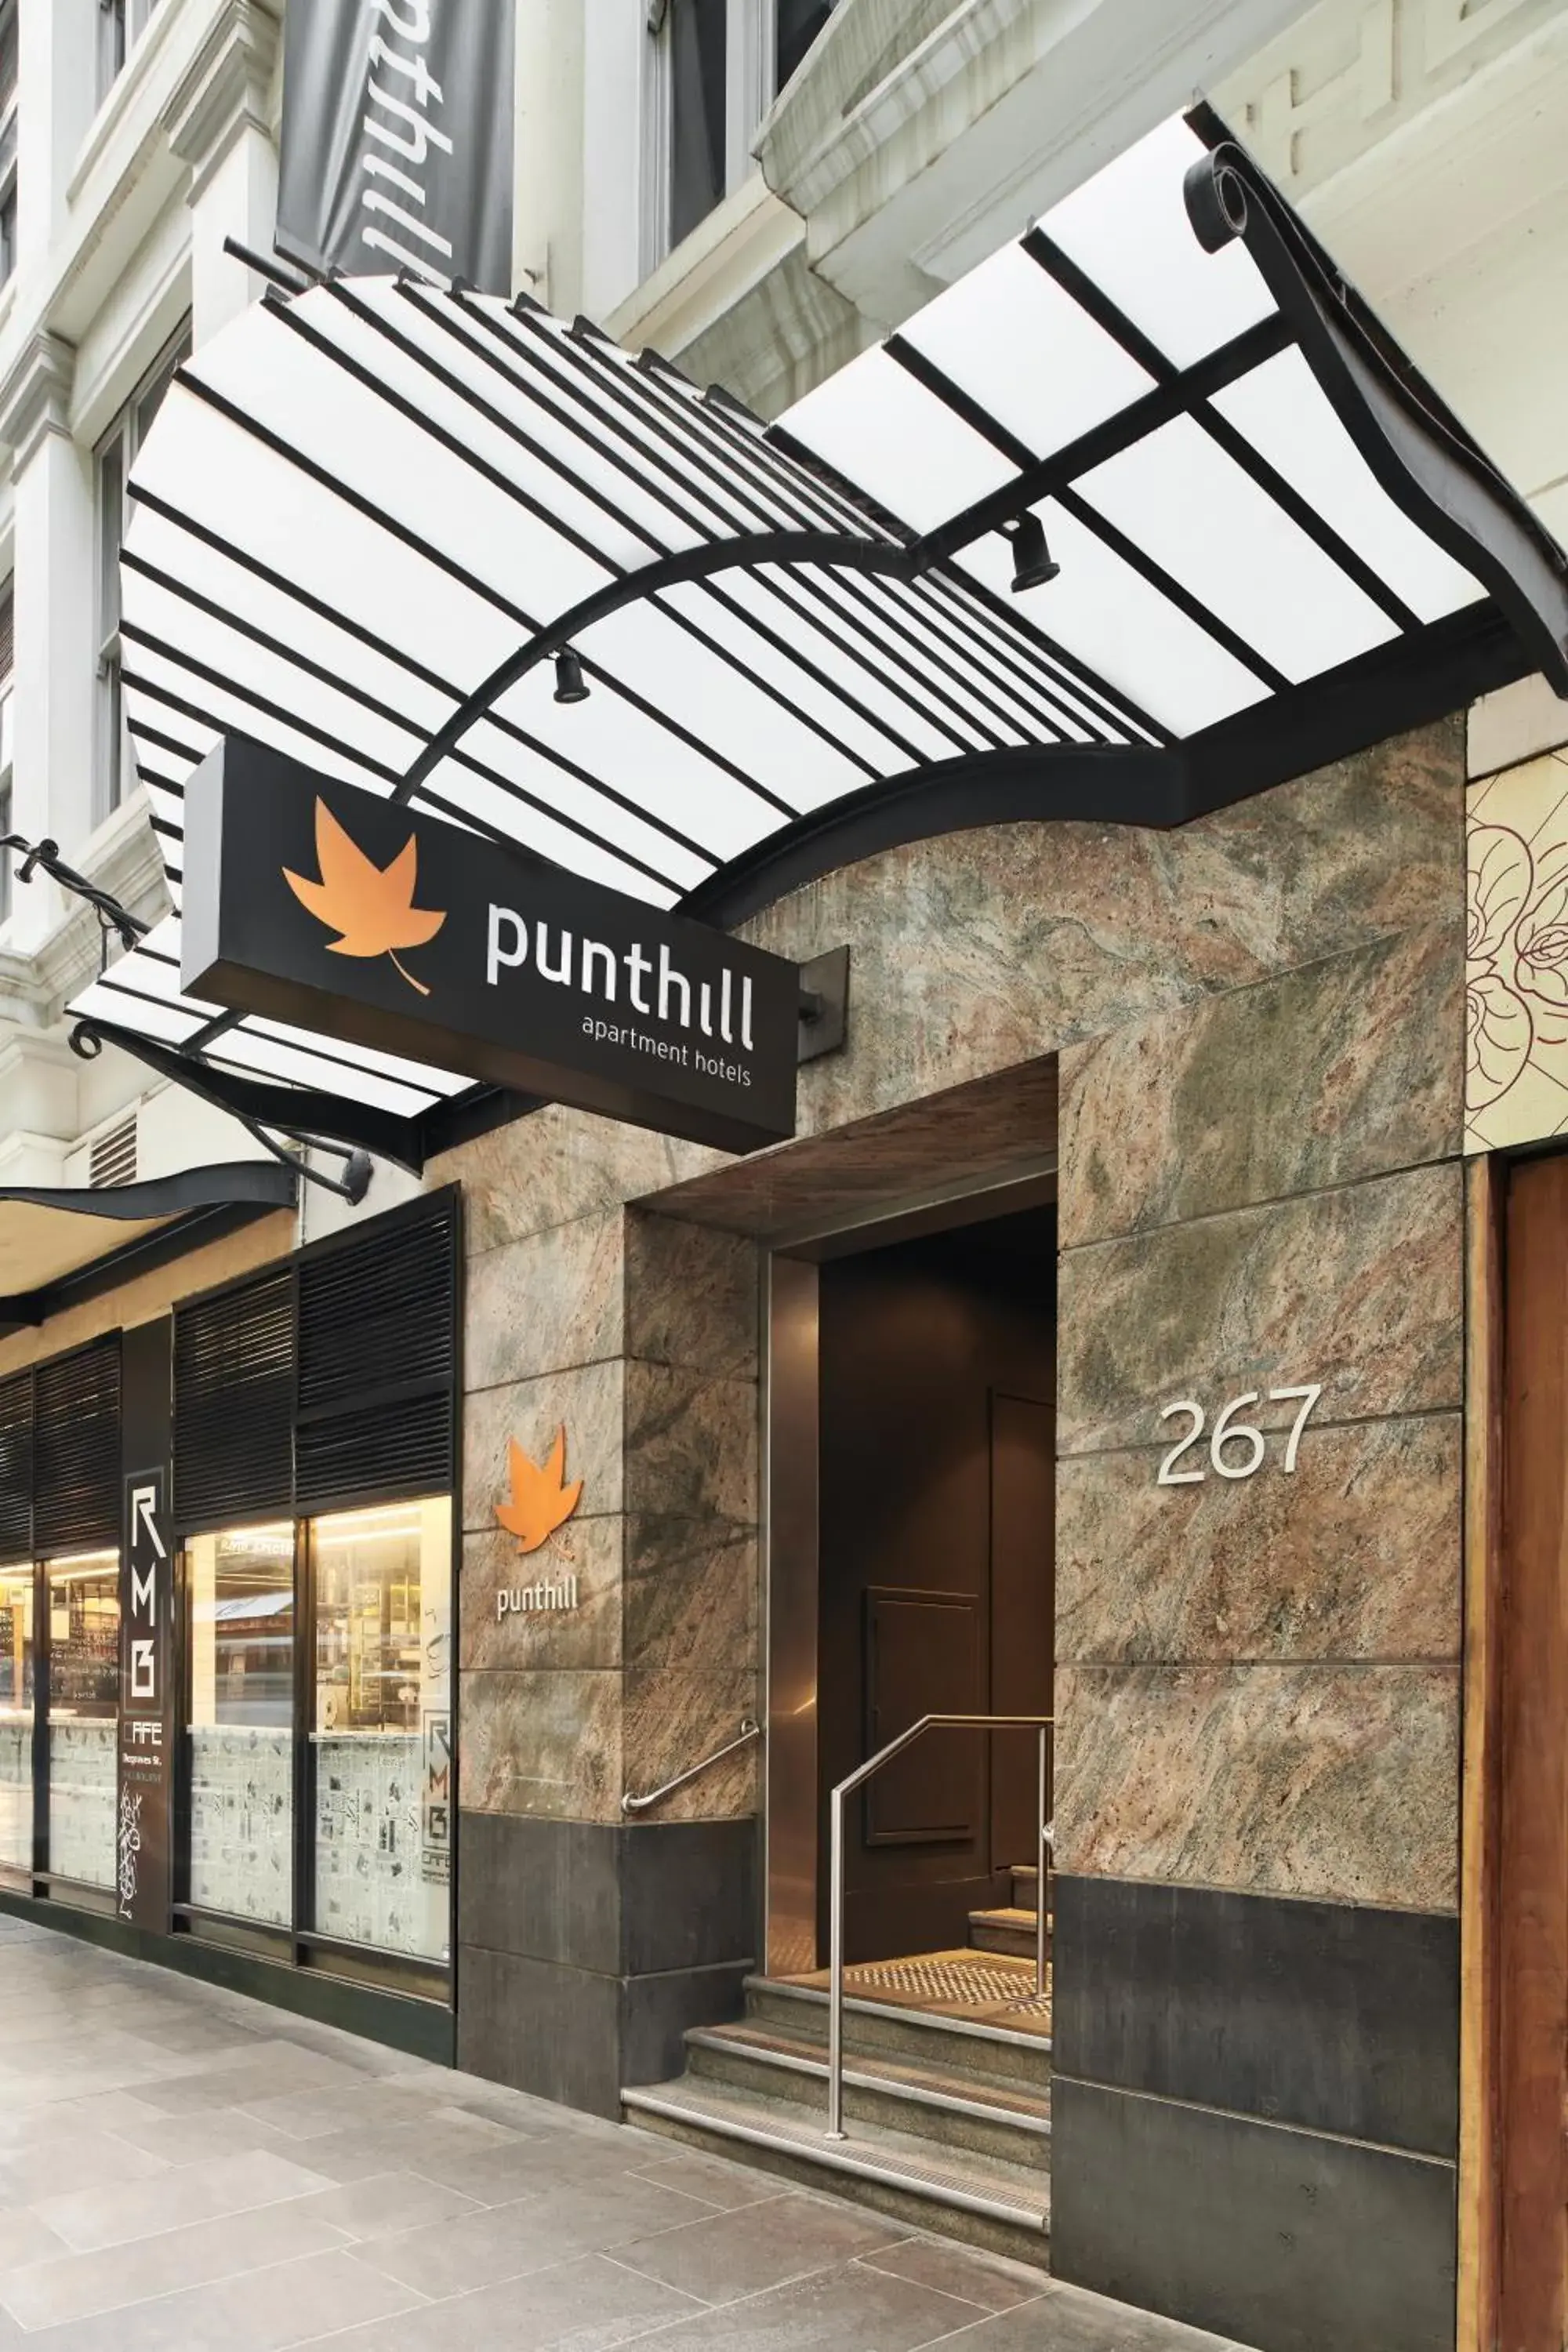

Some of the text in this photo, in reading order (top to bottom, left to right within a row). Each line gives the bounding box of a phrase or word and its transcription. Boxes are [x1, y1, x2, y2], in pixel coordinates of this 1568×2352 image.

[487, 902, 753, 1051] punthill
[582, 1016, 752, 1087] apartment hotels
[1157, 1384, 1321, 1485] 267
[497, 1573, 578, 1622] punthill
